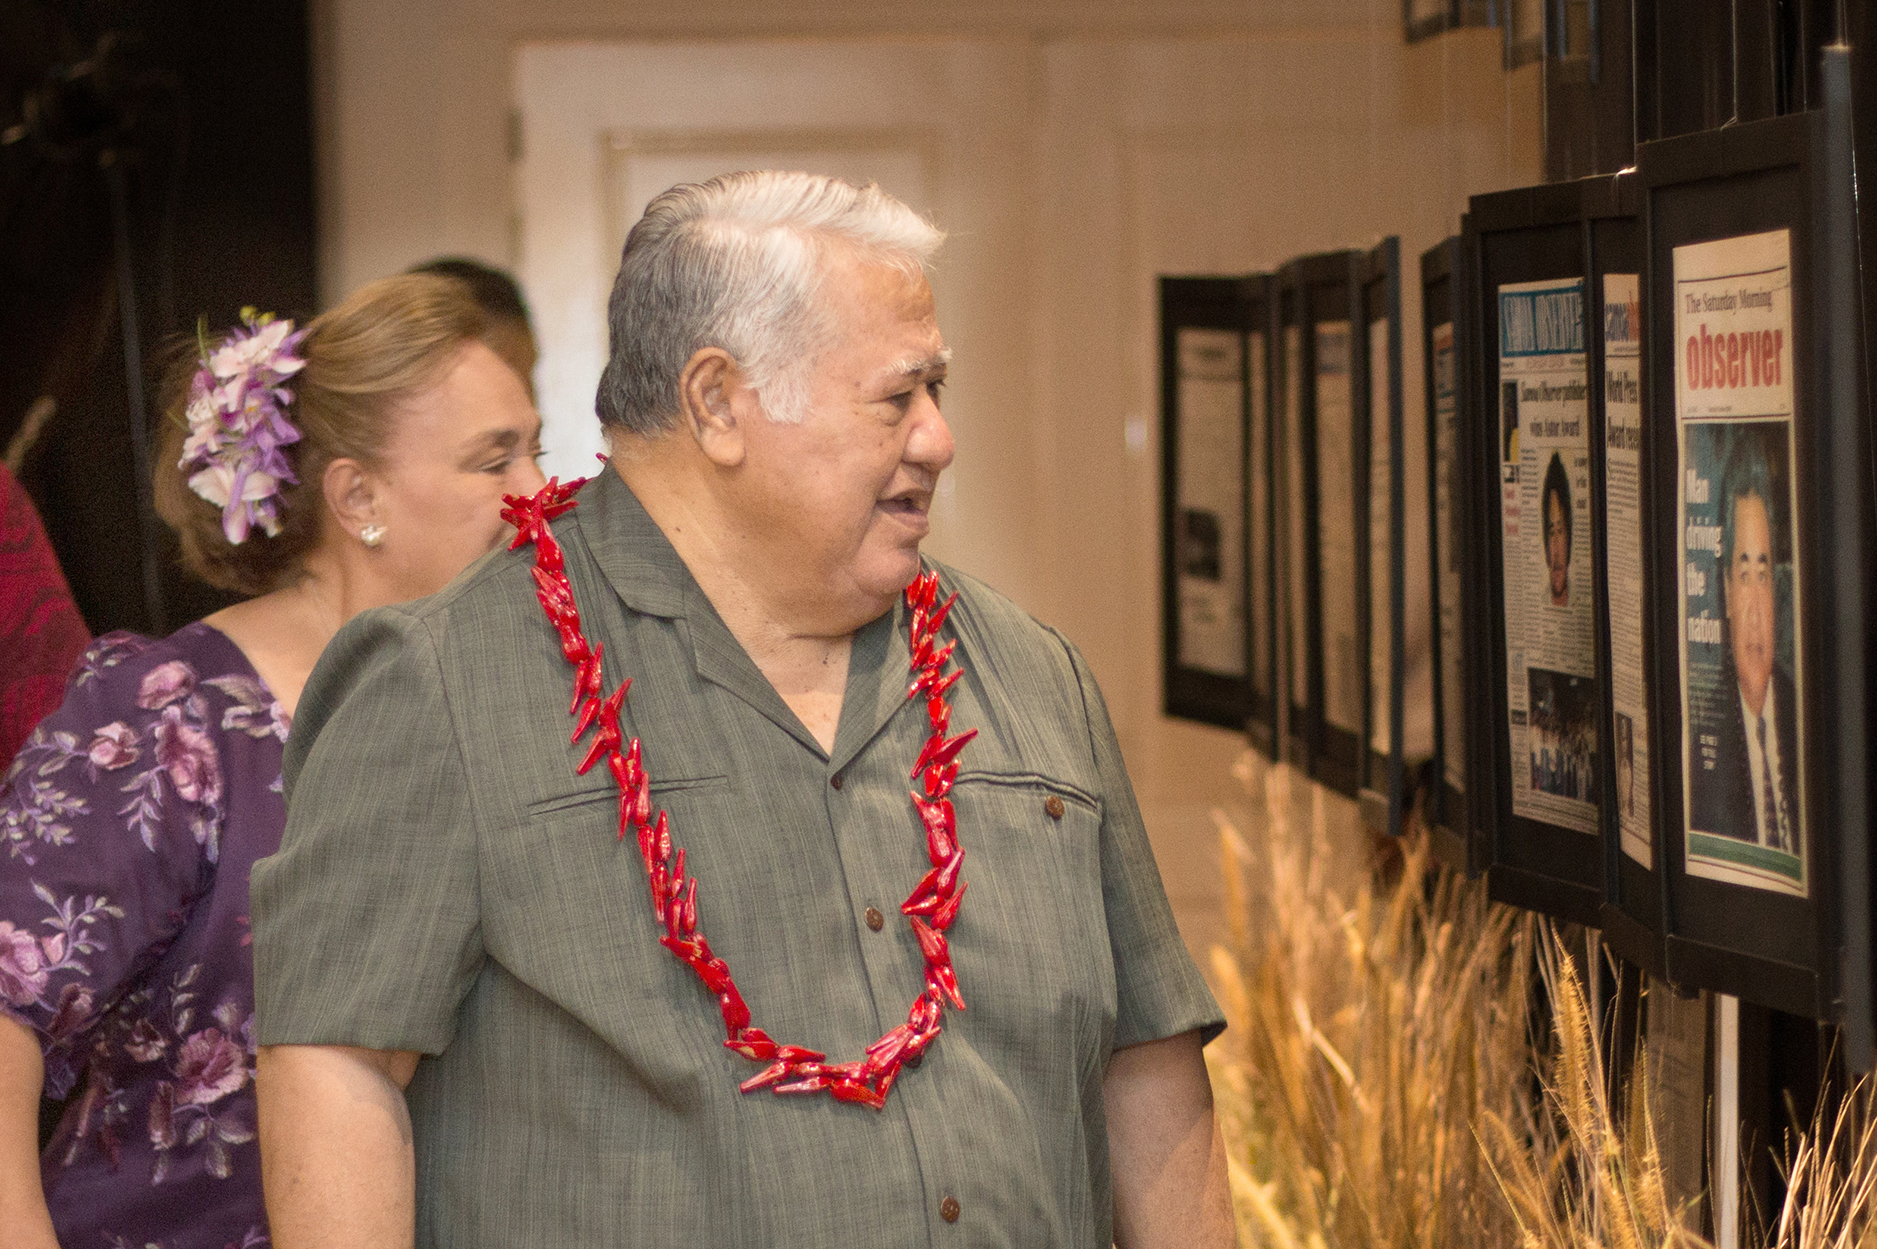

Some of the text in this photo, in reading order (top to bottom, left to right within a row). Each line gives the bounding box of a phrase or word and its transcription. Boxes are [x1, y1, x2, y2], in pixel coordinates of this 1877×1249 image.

[1685, 287, 1773, 315] The Saturday Morning
[1686, 323, 1783, 390] observer
[1686, 469, 1710, 504] Man
[1686, 516, 1723, 558] driving
[1687, 562, 1707, 597] the
[1687, 610, 1722, 644] nation
